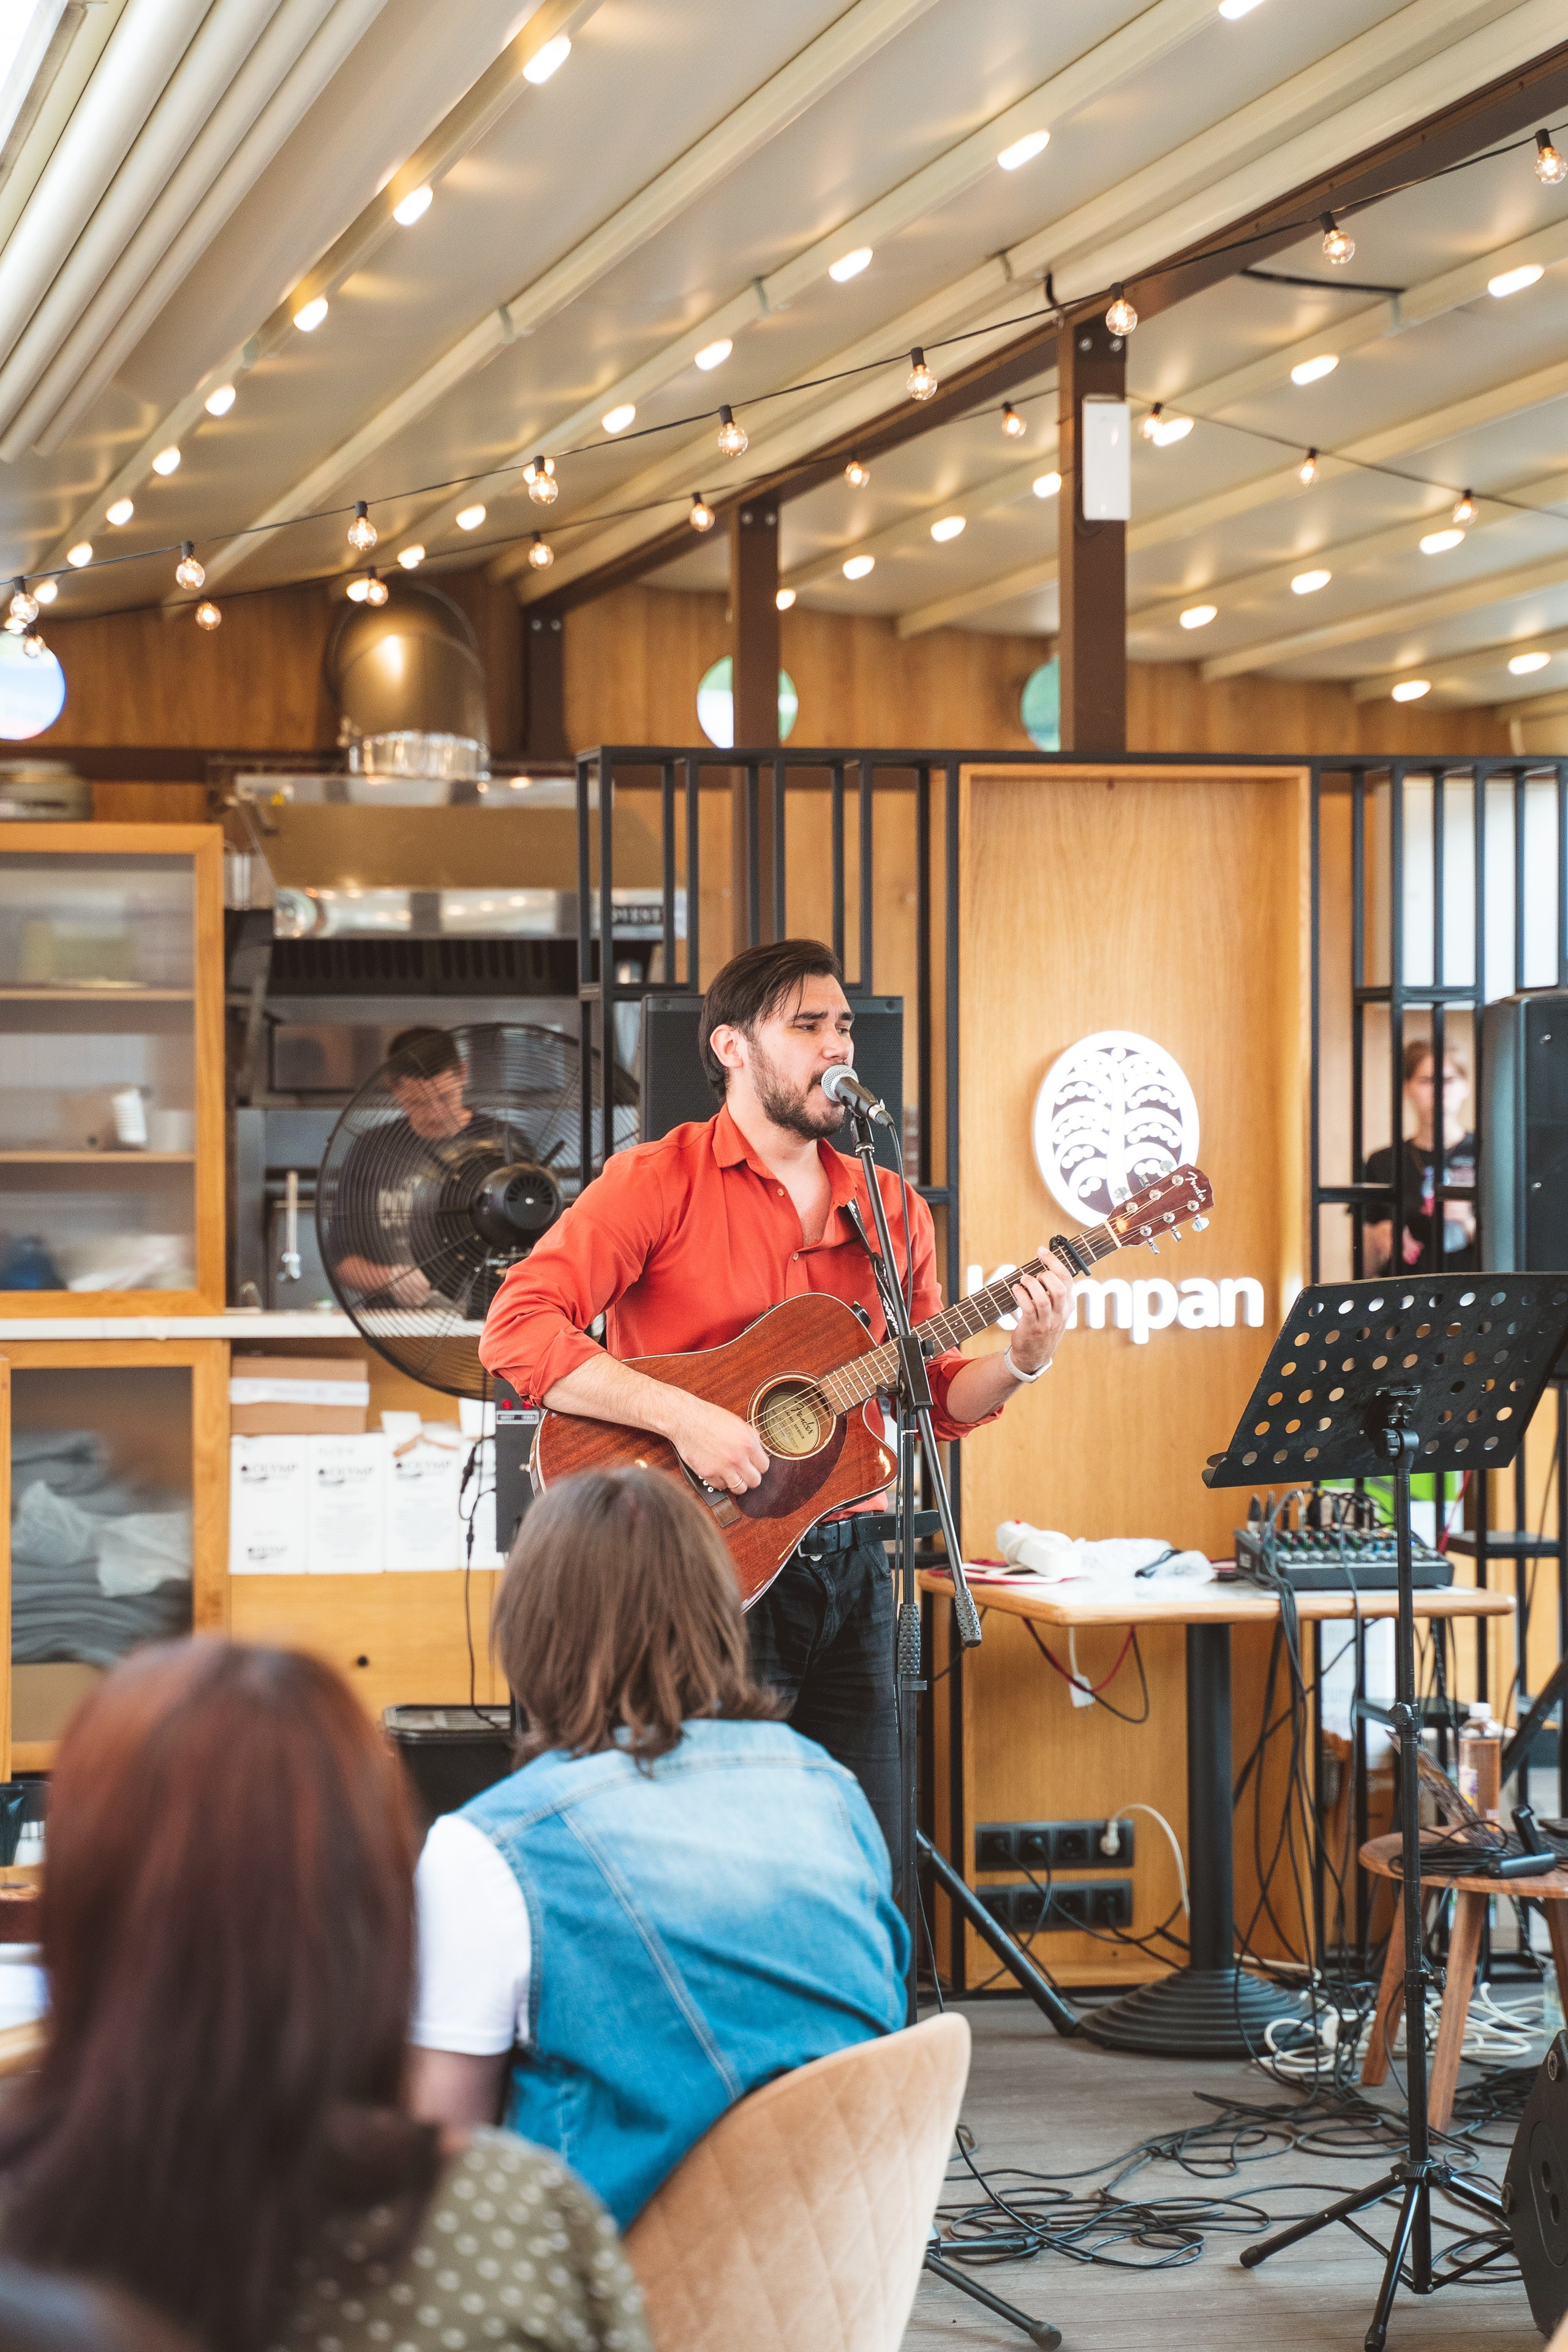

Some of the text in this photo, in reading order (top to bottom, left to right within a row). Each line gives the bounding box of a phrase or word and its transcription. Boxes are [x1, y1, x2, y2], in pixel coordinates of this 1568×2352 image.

[1185, 1171, 1207, 1202] Fender
[967, 1264, 1264, 1344] Kmpan
[791, 1401, 815, 1434] Fender
